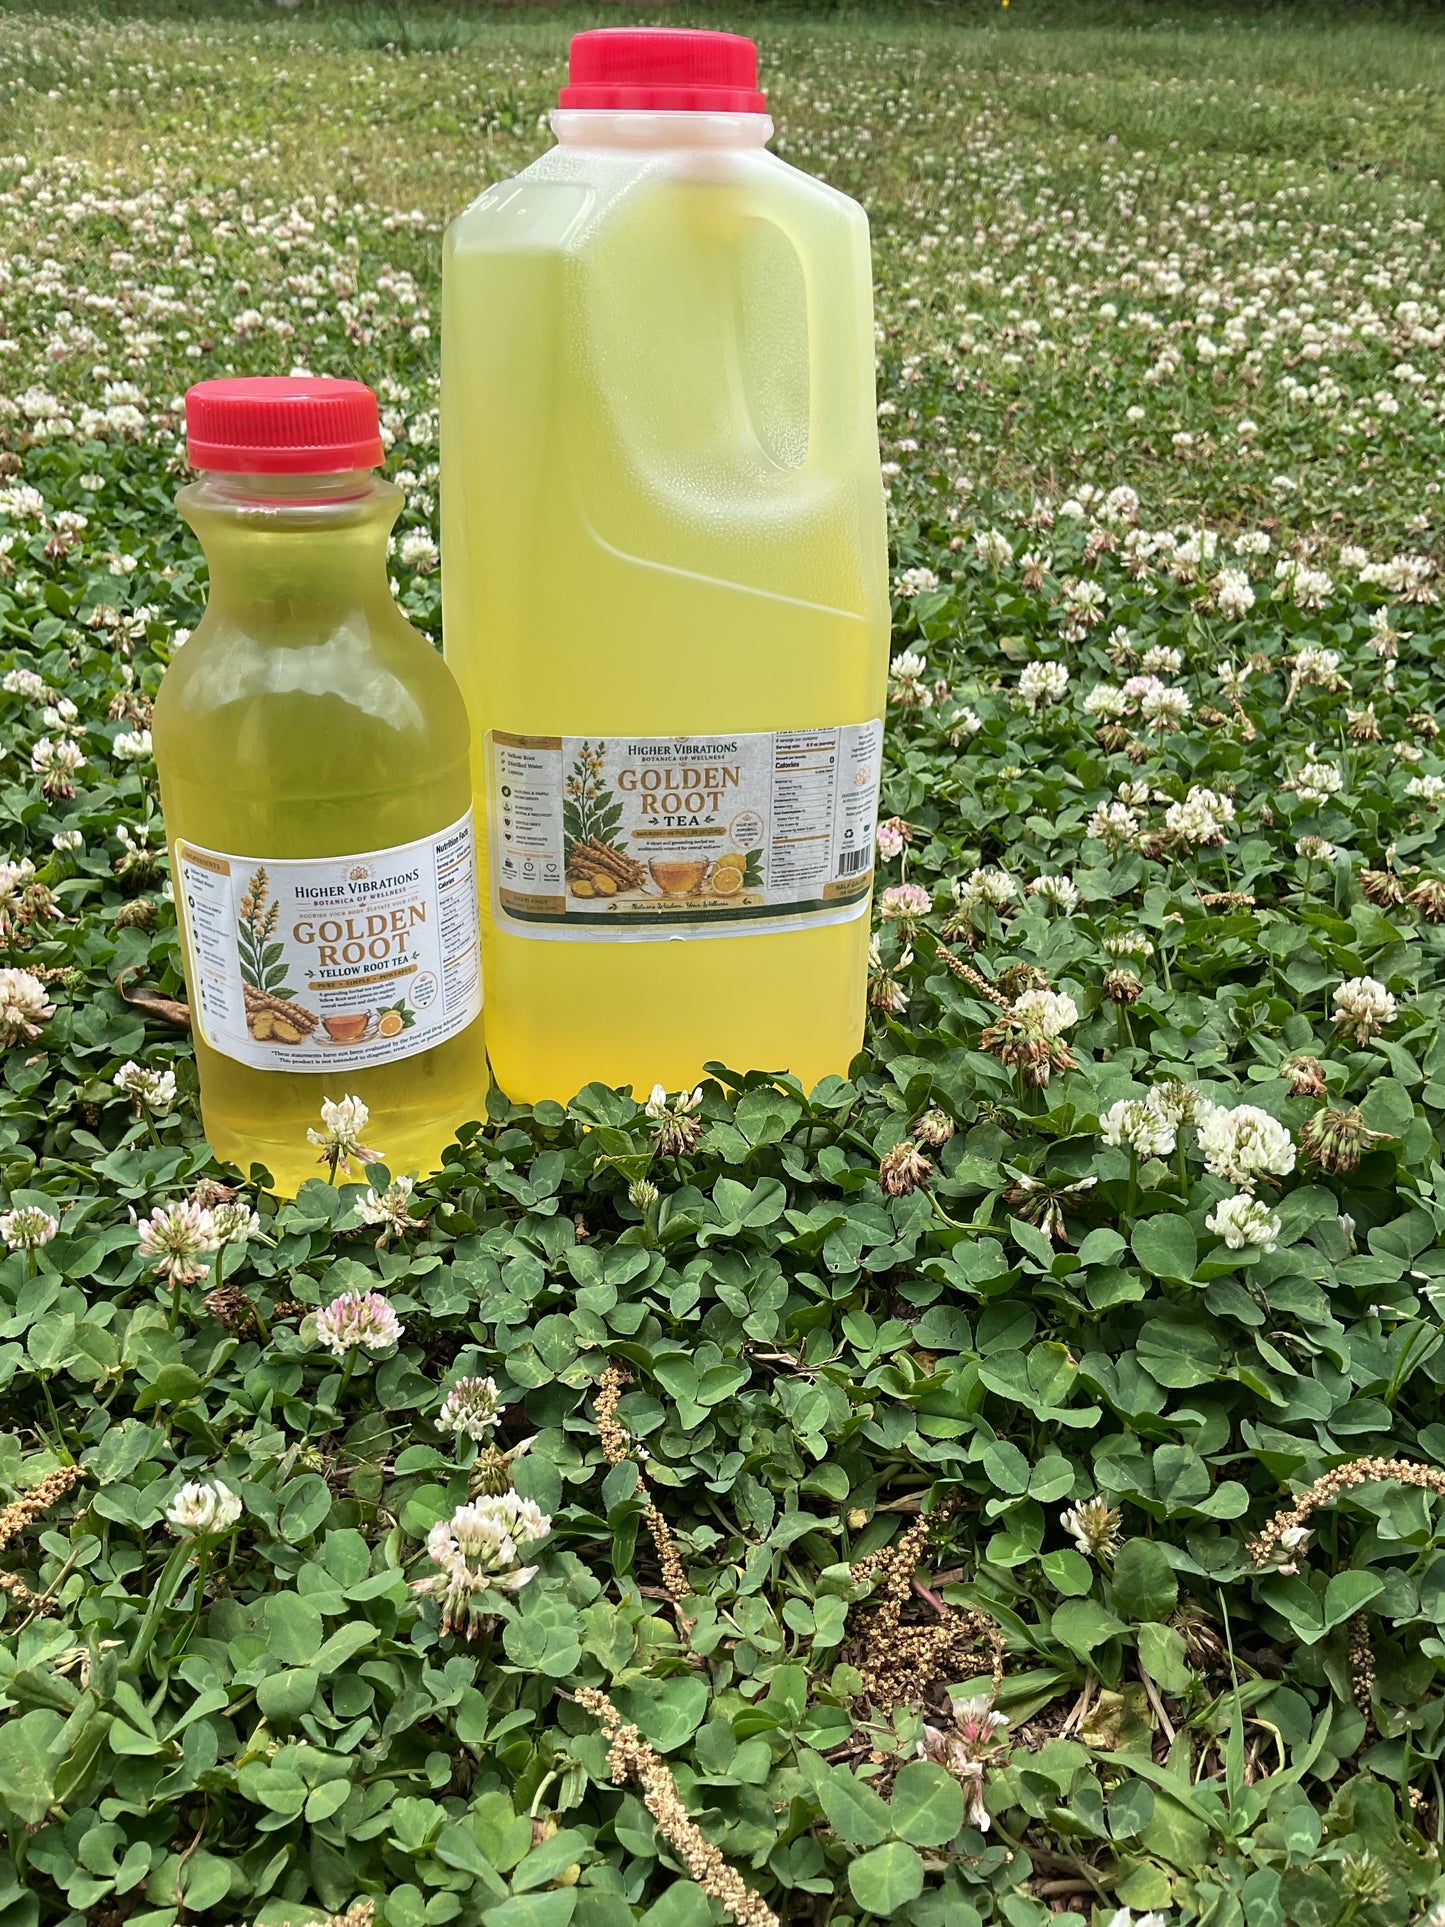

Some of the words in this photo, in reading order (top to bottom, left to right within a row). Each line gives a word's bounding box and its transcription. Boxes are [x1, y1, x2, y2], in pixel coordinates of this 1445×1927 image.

[628, 744, 671, 756] HIGHER
[673, 741, 738, 755] VIBRATIONS
[691, 754, 725, 762] WELLNESS
[617, 766, 741, 791] GOLDEN
[641, 791, 724, 815] ROOT
[664, 816, 700, 827] TEA
[436, 836, 459, 854] Nutrition
[458, 828, 469, 841] Facts
[295, 886, 345, 898] HIGHER
[348, 868, 419, 894] VIBRATIONS
[438, 877, 455, 890] Calories
[314, 898, 354, 906] BOTANICA
[370, 887, 407, 900] WELLNESS
[702, 900, 728, 908] Wellness
[293, 901, 427, 944] GOLDEN
[317, 930, 411, 967] ROOT
[319, 966, 361, 978] YELLOW
[363, 960, 390, 973] ROOT
[392, 955, 409, 967] TEA
[345, 978, 370, 986] SIMPLE
[364, 1043, 392, 1052] evaluated
[409, 1032, 422, 1041] Food
[432, 1024, 442, 1032] Drug
[333, 1056, 358, 1064] intended
